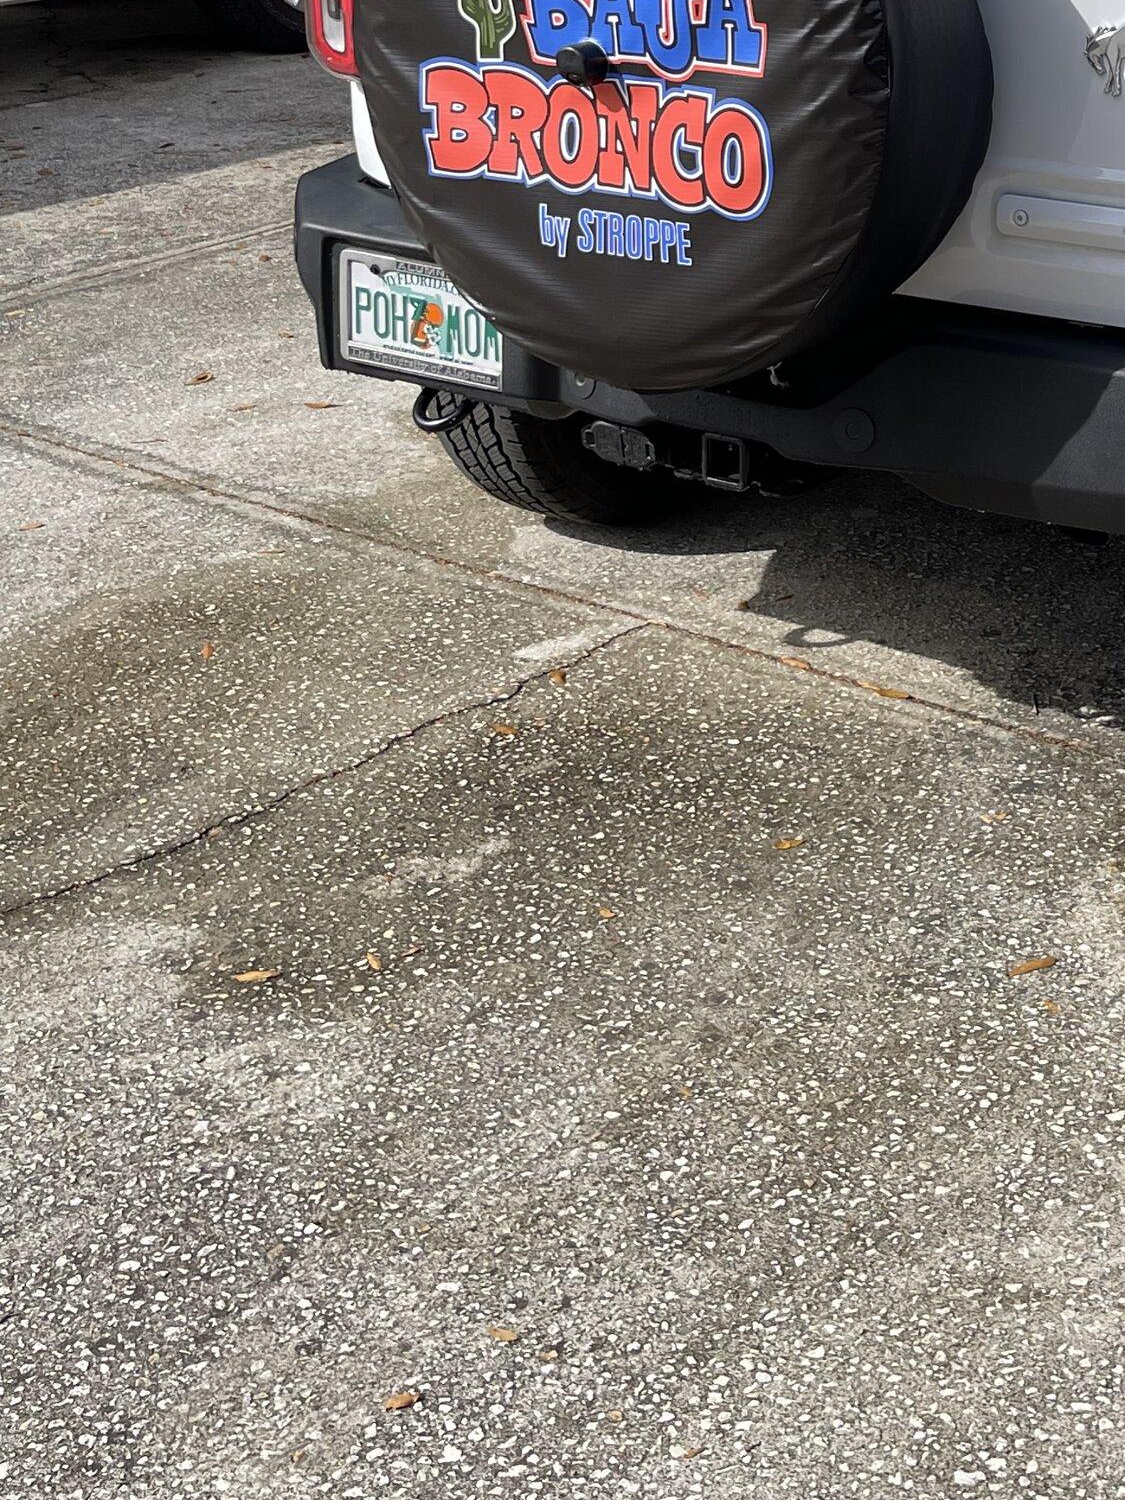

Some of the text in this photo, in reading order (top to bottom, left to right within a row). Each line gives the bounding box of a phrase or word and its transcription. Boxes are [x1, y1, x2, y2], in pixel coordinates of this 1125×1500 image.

[418, 56, 775, 222] BRONCO
[538, 203, 693, 266] by STROPPE
[351, 349, 370, 361] The
[373, 351, 429, 373] University
[445, 366, 491, 383] Alabama
